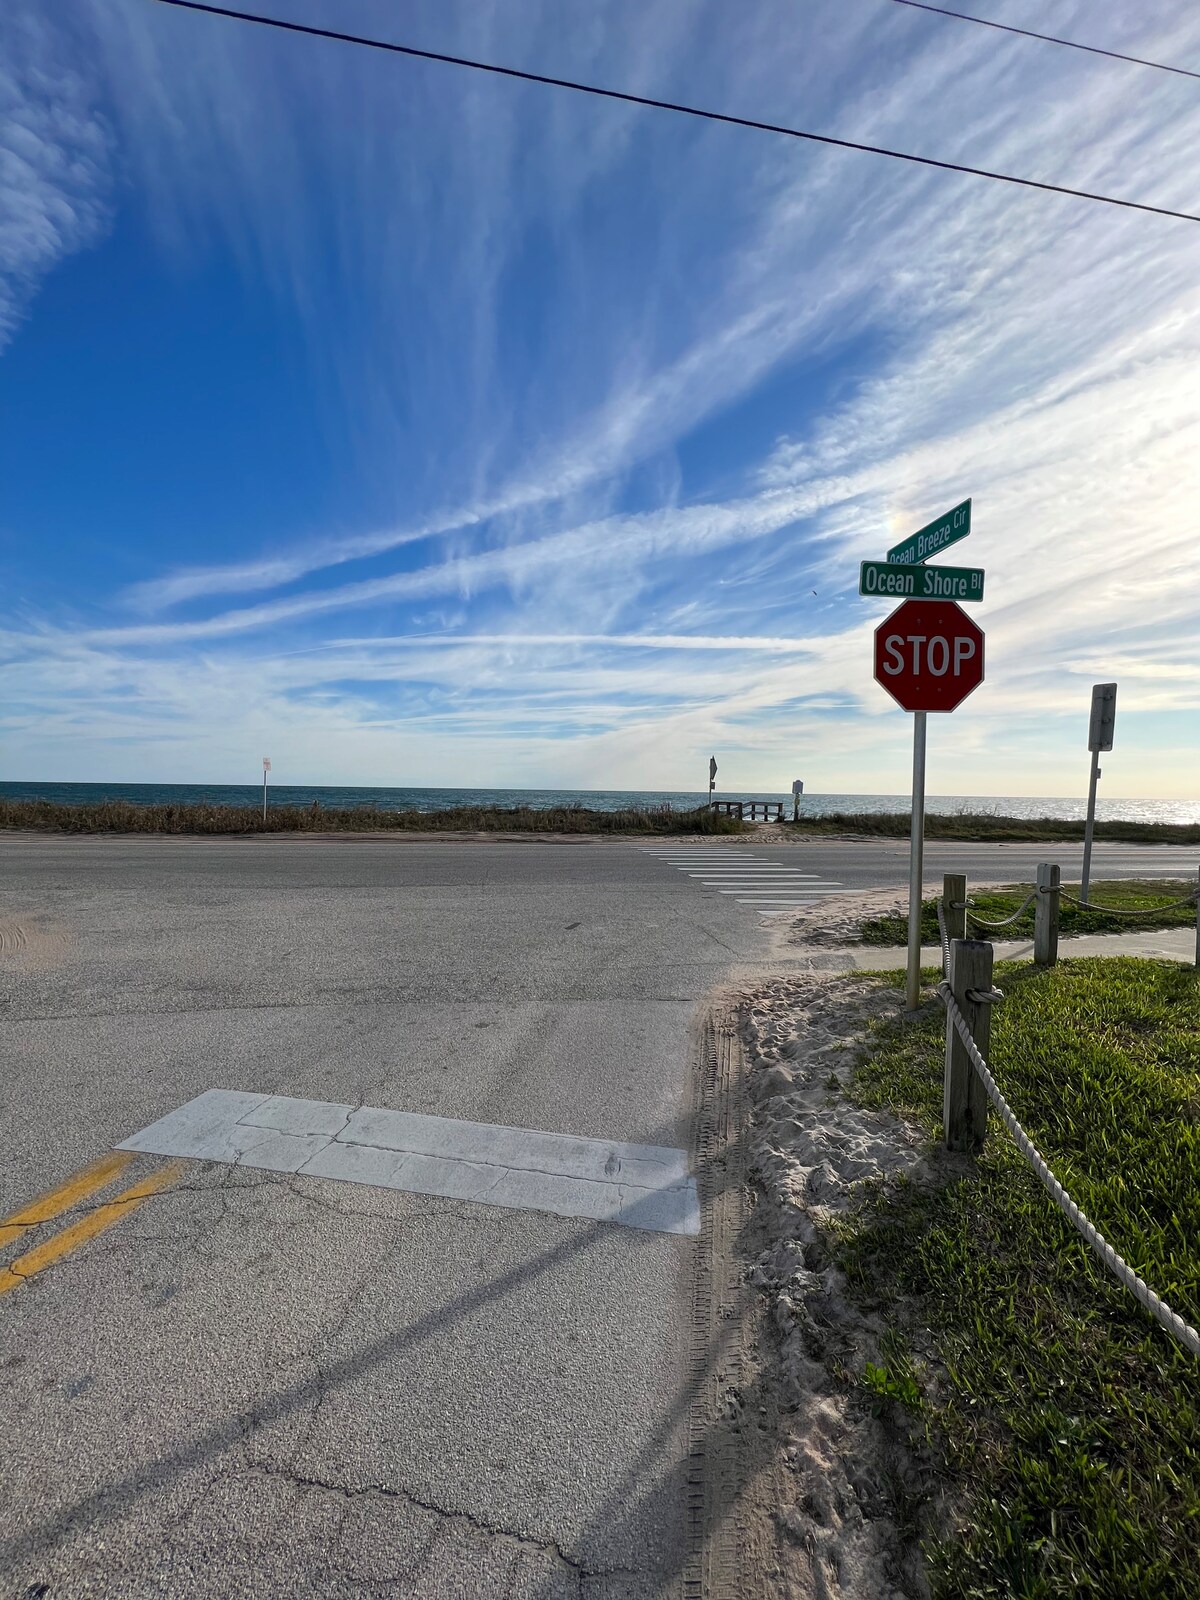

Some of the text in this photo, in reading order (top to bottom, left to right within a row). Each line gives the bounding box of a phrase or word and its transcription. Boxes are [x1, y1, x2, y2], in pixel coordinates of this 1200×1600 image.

[918, 525, 951, 557] Breeze
[953, 508, 967, 529] Cir
[865, 566, 914, 593] Ocean
[923, 569, 967, 596] Shore
[882, 634, 976, 677] STOP
